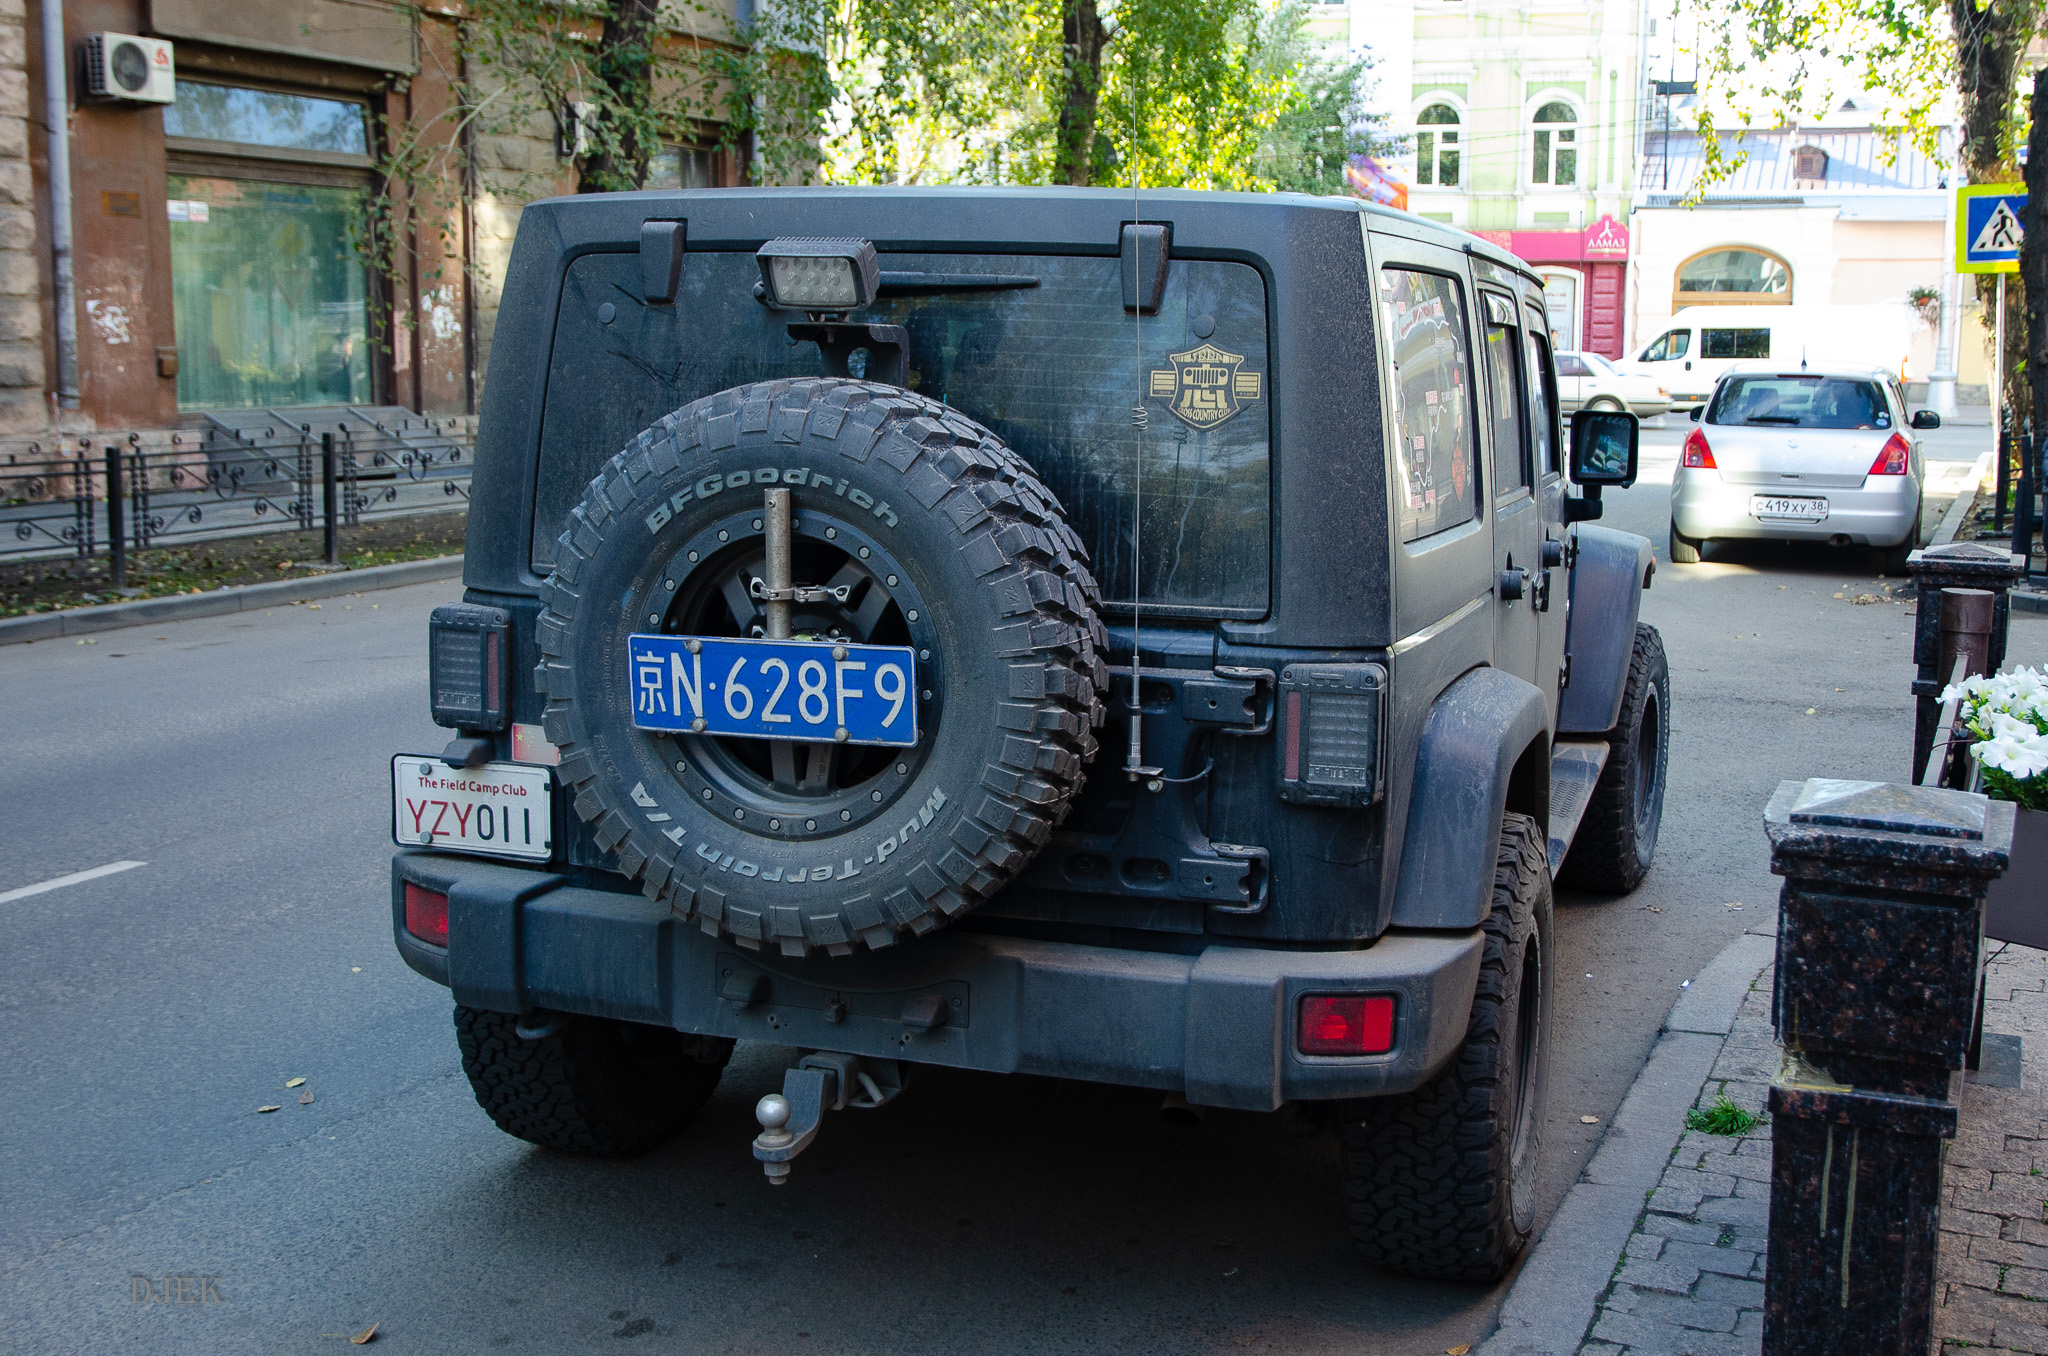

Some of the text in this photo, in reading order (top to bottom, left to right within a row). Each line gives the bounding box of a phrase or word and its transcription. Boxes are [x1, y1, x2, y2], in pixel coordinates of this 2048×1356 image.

[1587, 238, 1625, 248] АЛМАЗ
[1192, 408, 1218, 421] COUNTRY
[645, 467, 900, 535] BFGoodrich
[418, 777, 527, 796] The Field Camp Club
[630, 781, 687, 847] T/A
[696, 786, 947, 884] Mud-Terrain
